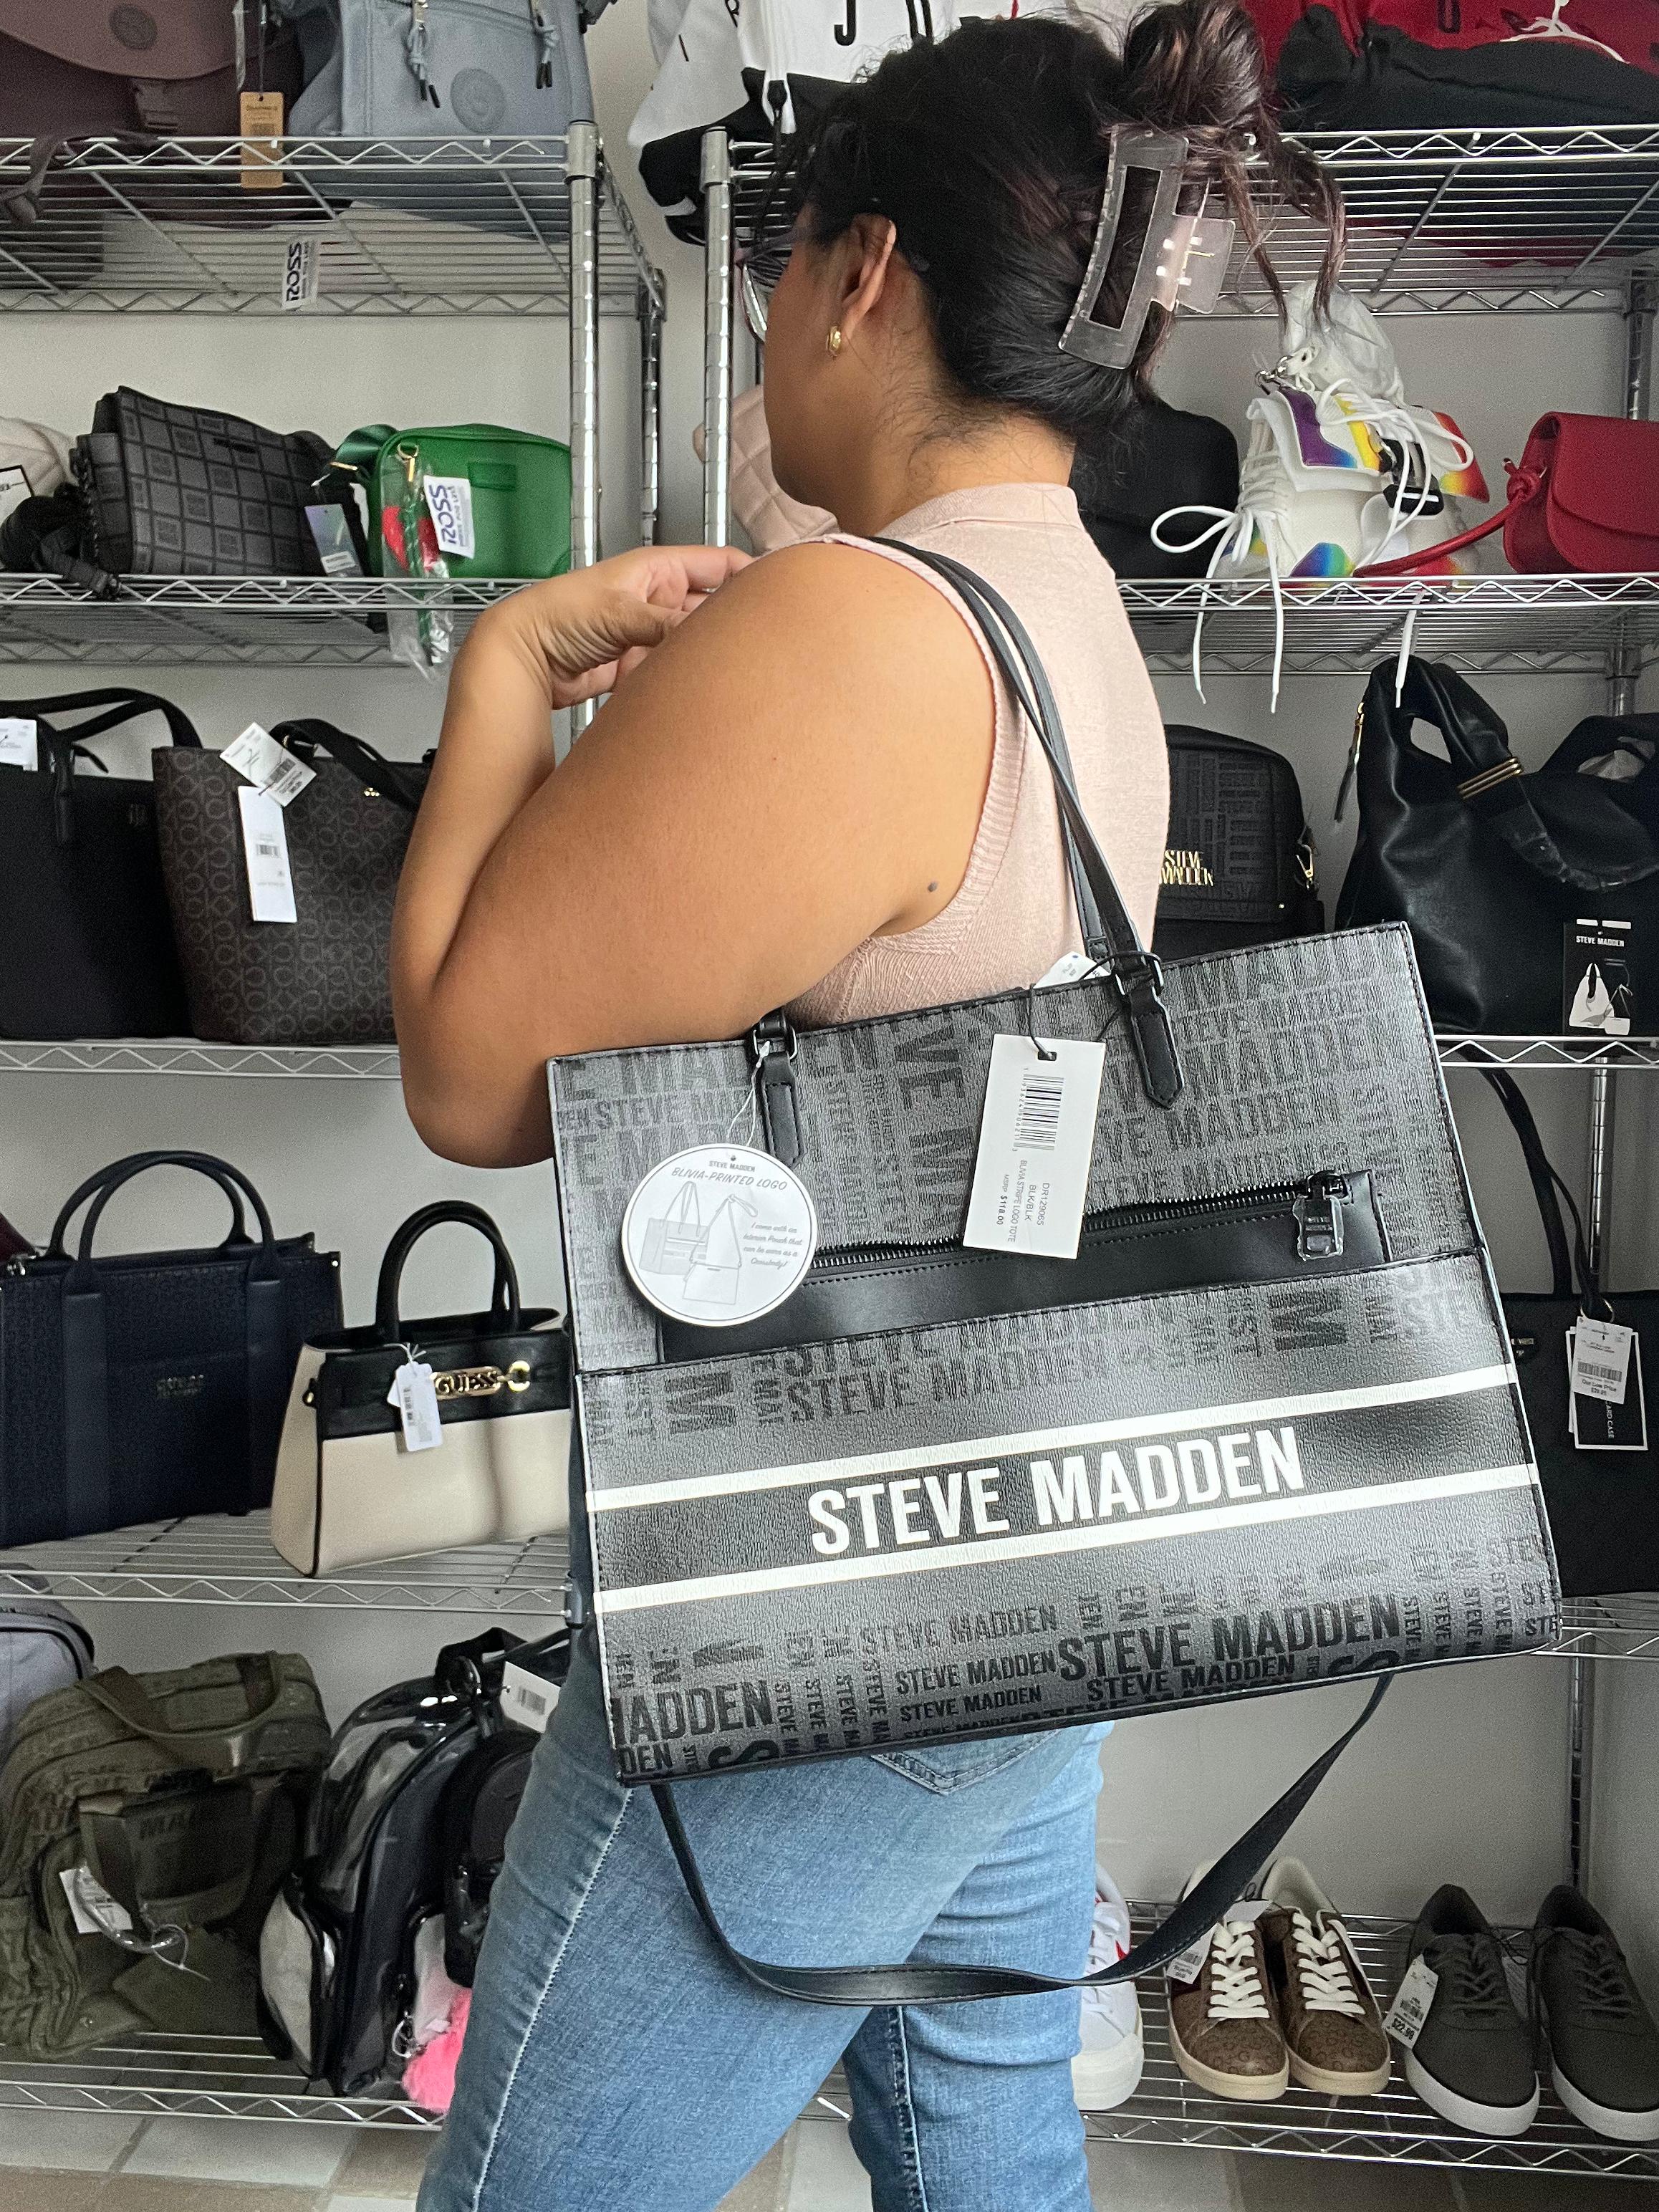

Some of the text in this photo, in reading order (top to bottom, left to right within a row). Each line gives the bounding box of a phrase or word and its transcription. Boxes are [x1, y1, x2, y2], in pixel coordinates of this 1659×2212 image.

[286, 242, 302, 302] ROSS
[428, 485, 456, 544] ROSS
[1576, 936, 1625, 947] STEVE MADDEN
[671, 1167, 788, 1191] BLIVIA-PRINTED LOGO
[708, 1160, 756, 1172] STEVE MADDEN
[996, 1195, 1008, 1226] $118.00
[1007, 1160, 1028, 1243] BLIVIA STRIPE LOGO TOTE
[1024, 1184, 1037, 1221] BLK/BLK
[435, 1370, 501, 1393] GUESS
[787, 1367, 916, 1423] STEVE
[808, 1426, 1305, 1556] STEVE MADDEN
[1058, 1622, 1195, 1681] STEVE
[1212, 1594, 1402, 1663] MADDEN
[895, 1650, 1056, 1695] STEVE MADDEN
[1087, 1654, 1295, 1702] STEVE MADDEN
[775, 1679, 798, 1734] STEVE
[805, 1678, 827, 1729] STEVE
[837, 1674, 859, 1727] STEVE
[899, 1685, 1042, 1724] STEVE MADDEN
